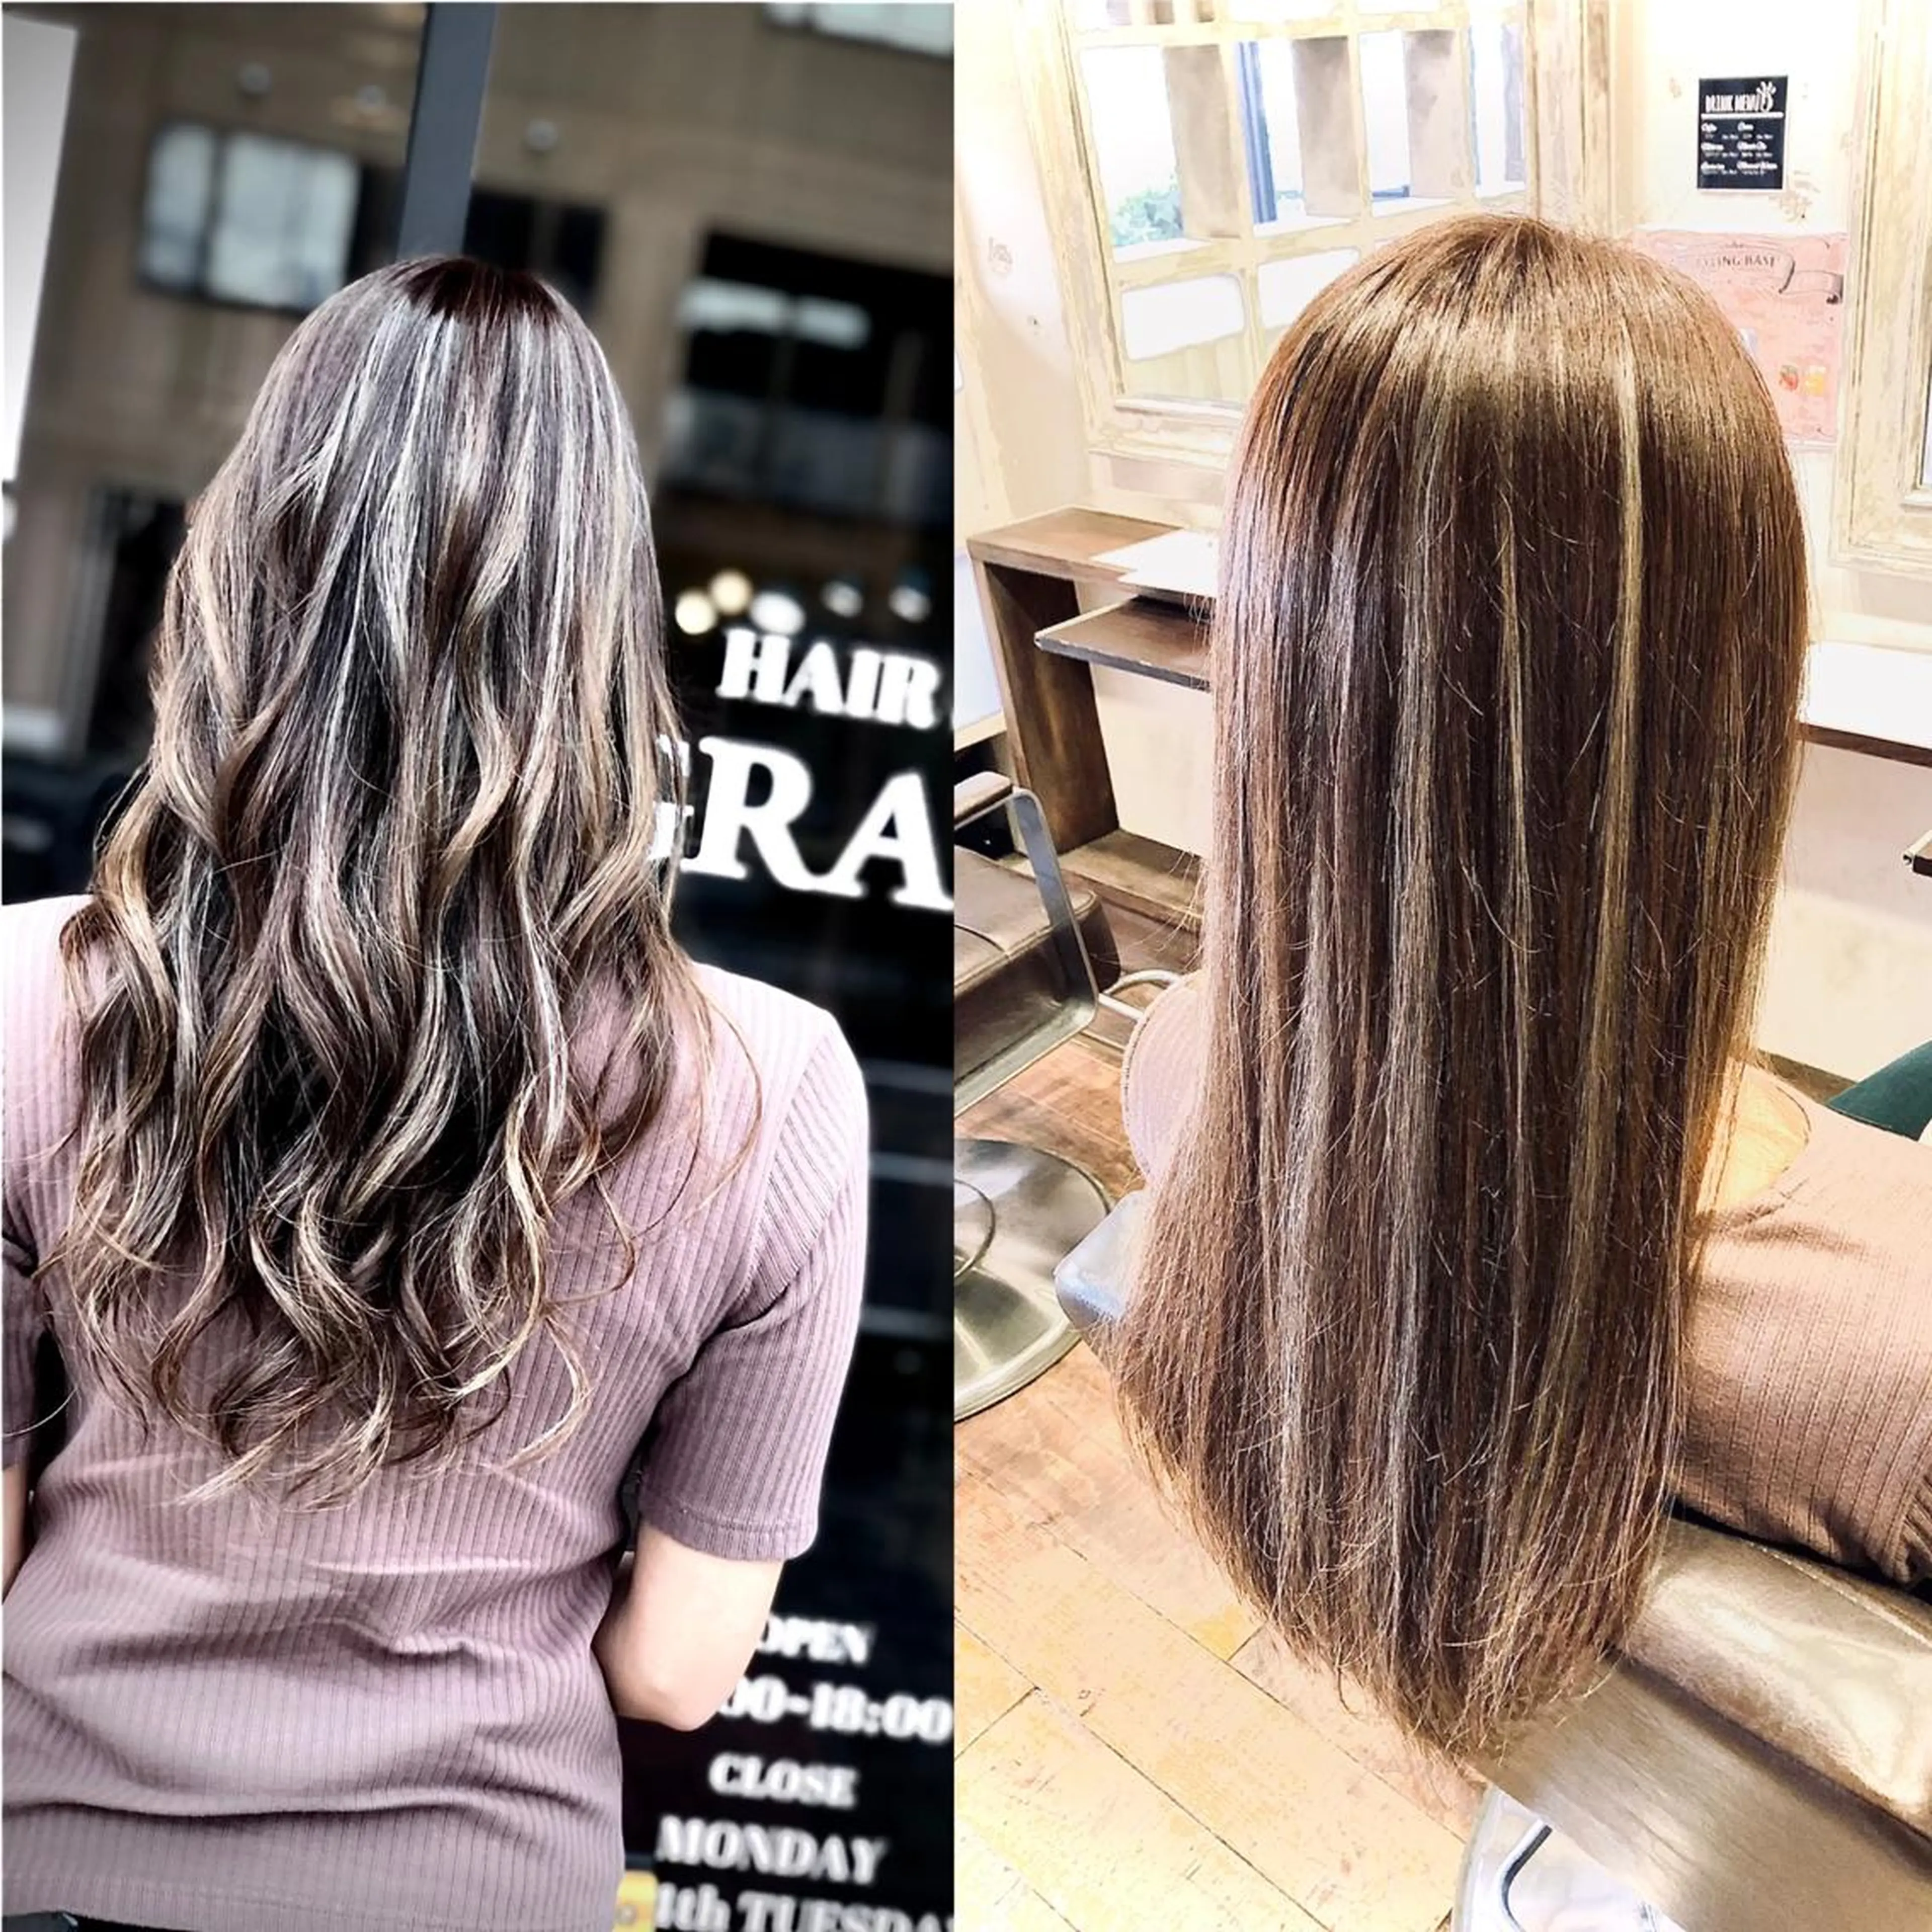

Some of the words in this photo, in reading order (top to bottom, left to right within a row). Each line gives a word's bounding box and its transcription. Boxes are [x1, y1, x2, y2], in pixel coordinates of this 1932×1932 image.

[716, 628, 939, 730] HAIR
[708, 1753, 856, 1807] CLOSE
[657, 1816, 884, 1884] MONDAY
